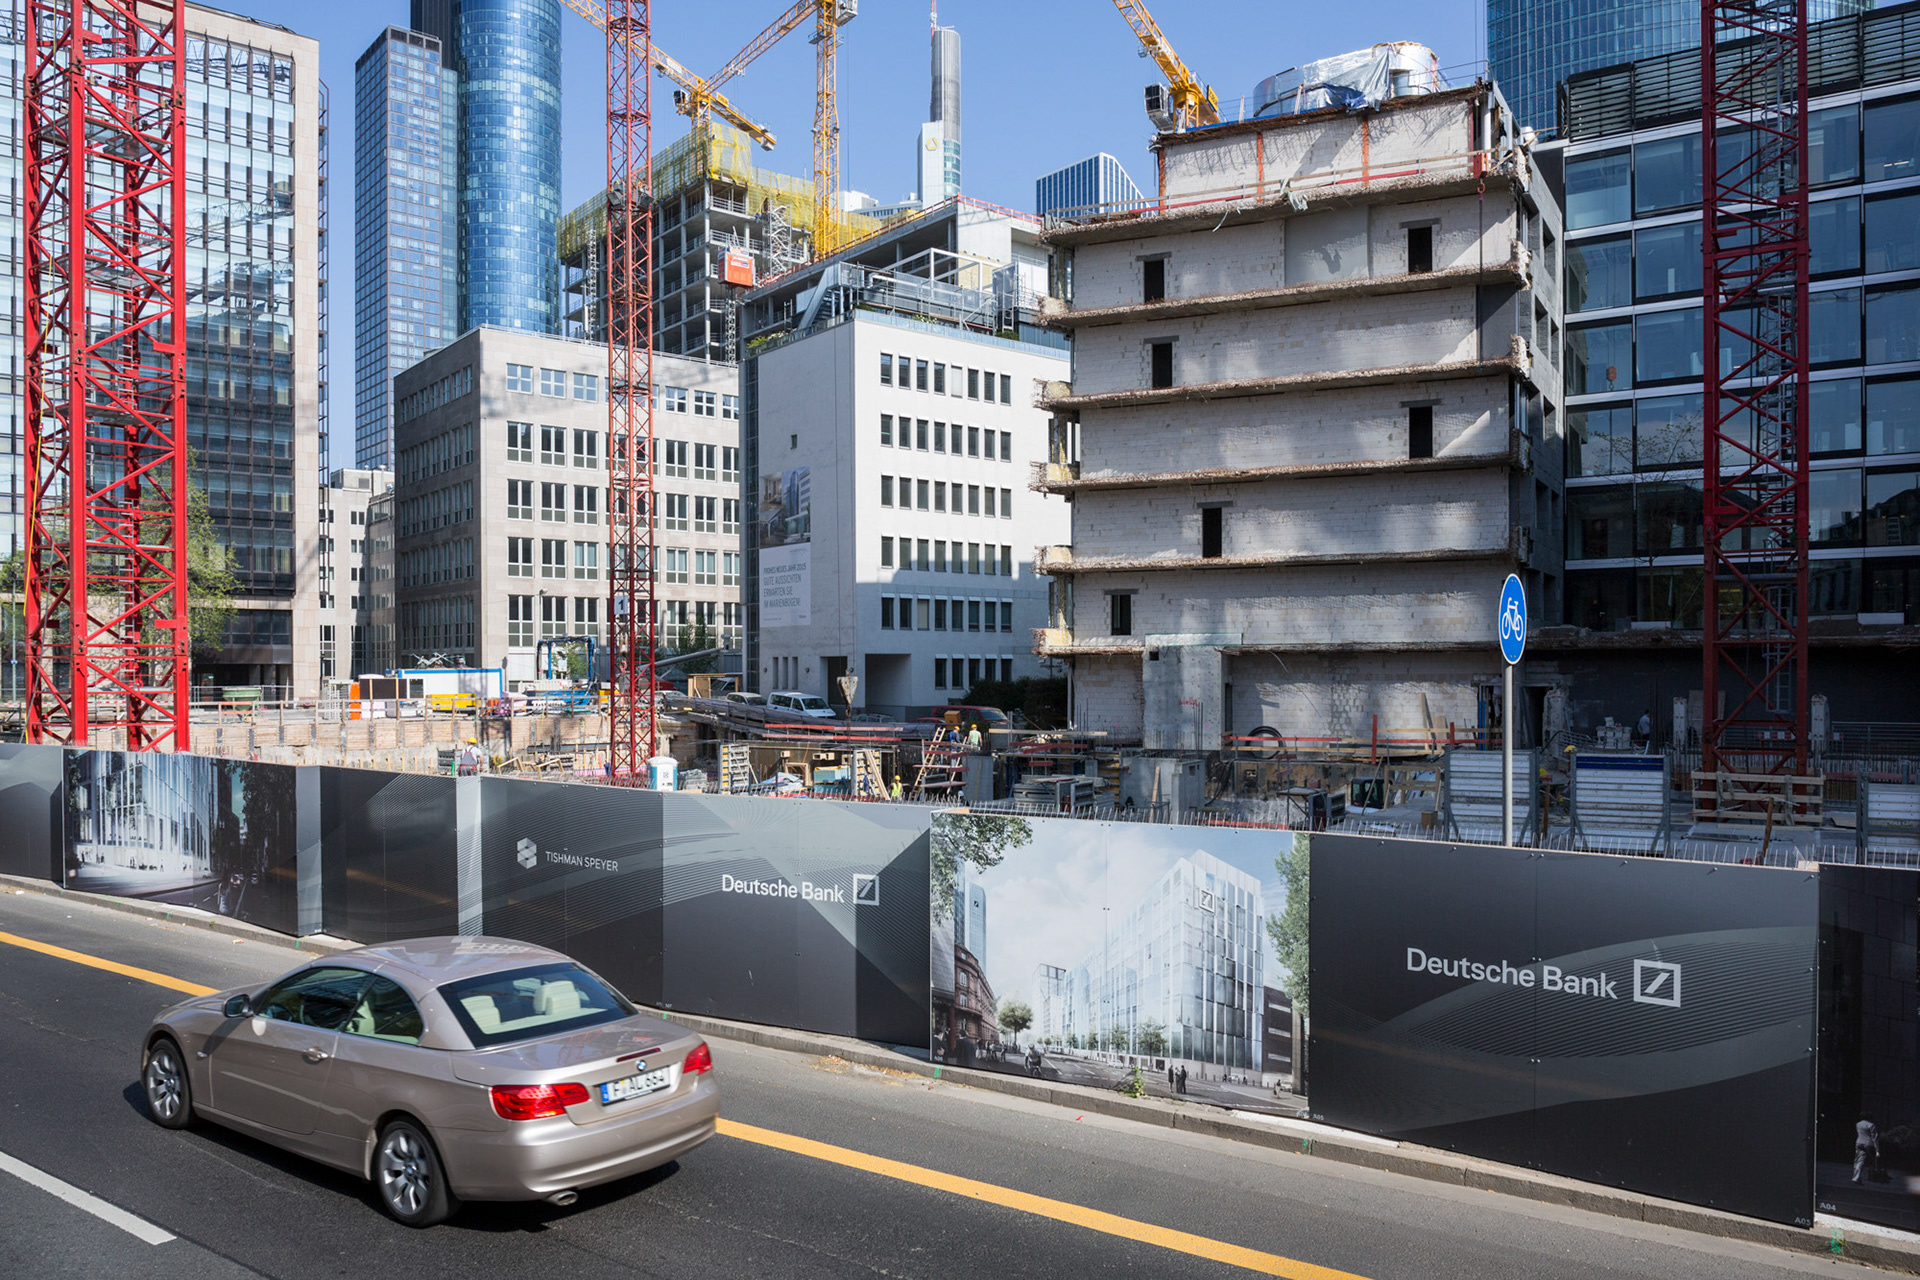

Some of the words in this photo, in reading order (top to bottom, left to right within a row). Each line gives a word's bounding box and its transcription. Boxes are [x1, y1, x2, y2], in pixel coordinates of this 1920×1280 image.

[763, 576, 774, 586] GUTE
[775, 573, 802, 585] AUSSICHTEN
[763, 586, 786, 598] ERWARTEN
[618, 599, 624, 611] 1
[545, 851, 583, 867] TISHMAN
[584, 856, 619, 873] SPEYER
[721, 874, 798, 899] Deutsche
[801, 881, 845, 903] Bank
[1407, 947, 1536, 988] Deutsche
[1542, 965, 1619, 1000] Bank
[1819, 1202, 1837, 1211] A04
[1794, 1216, 1812, 1226] A05
